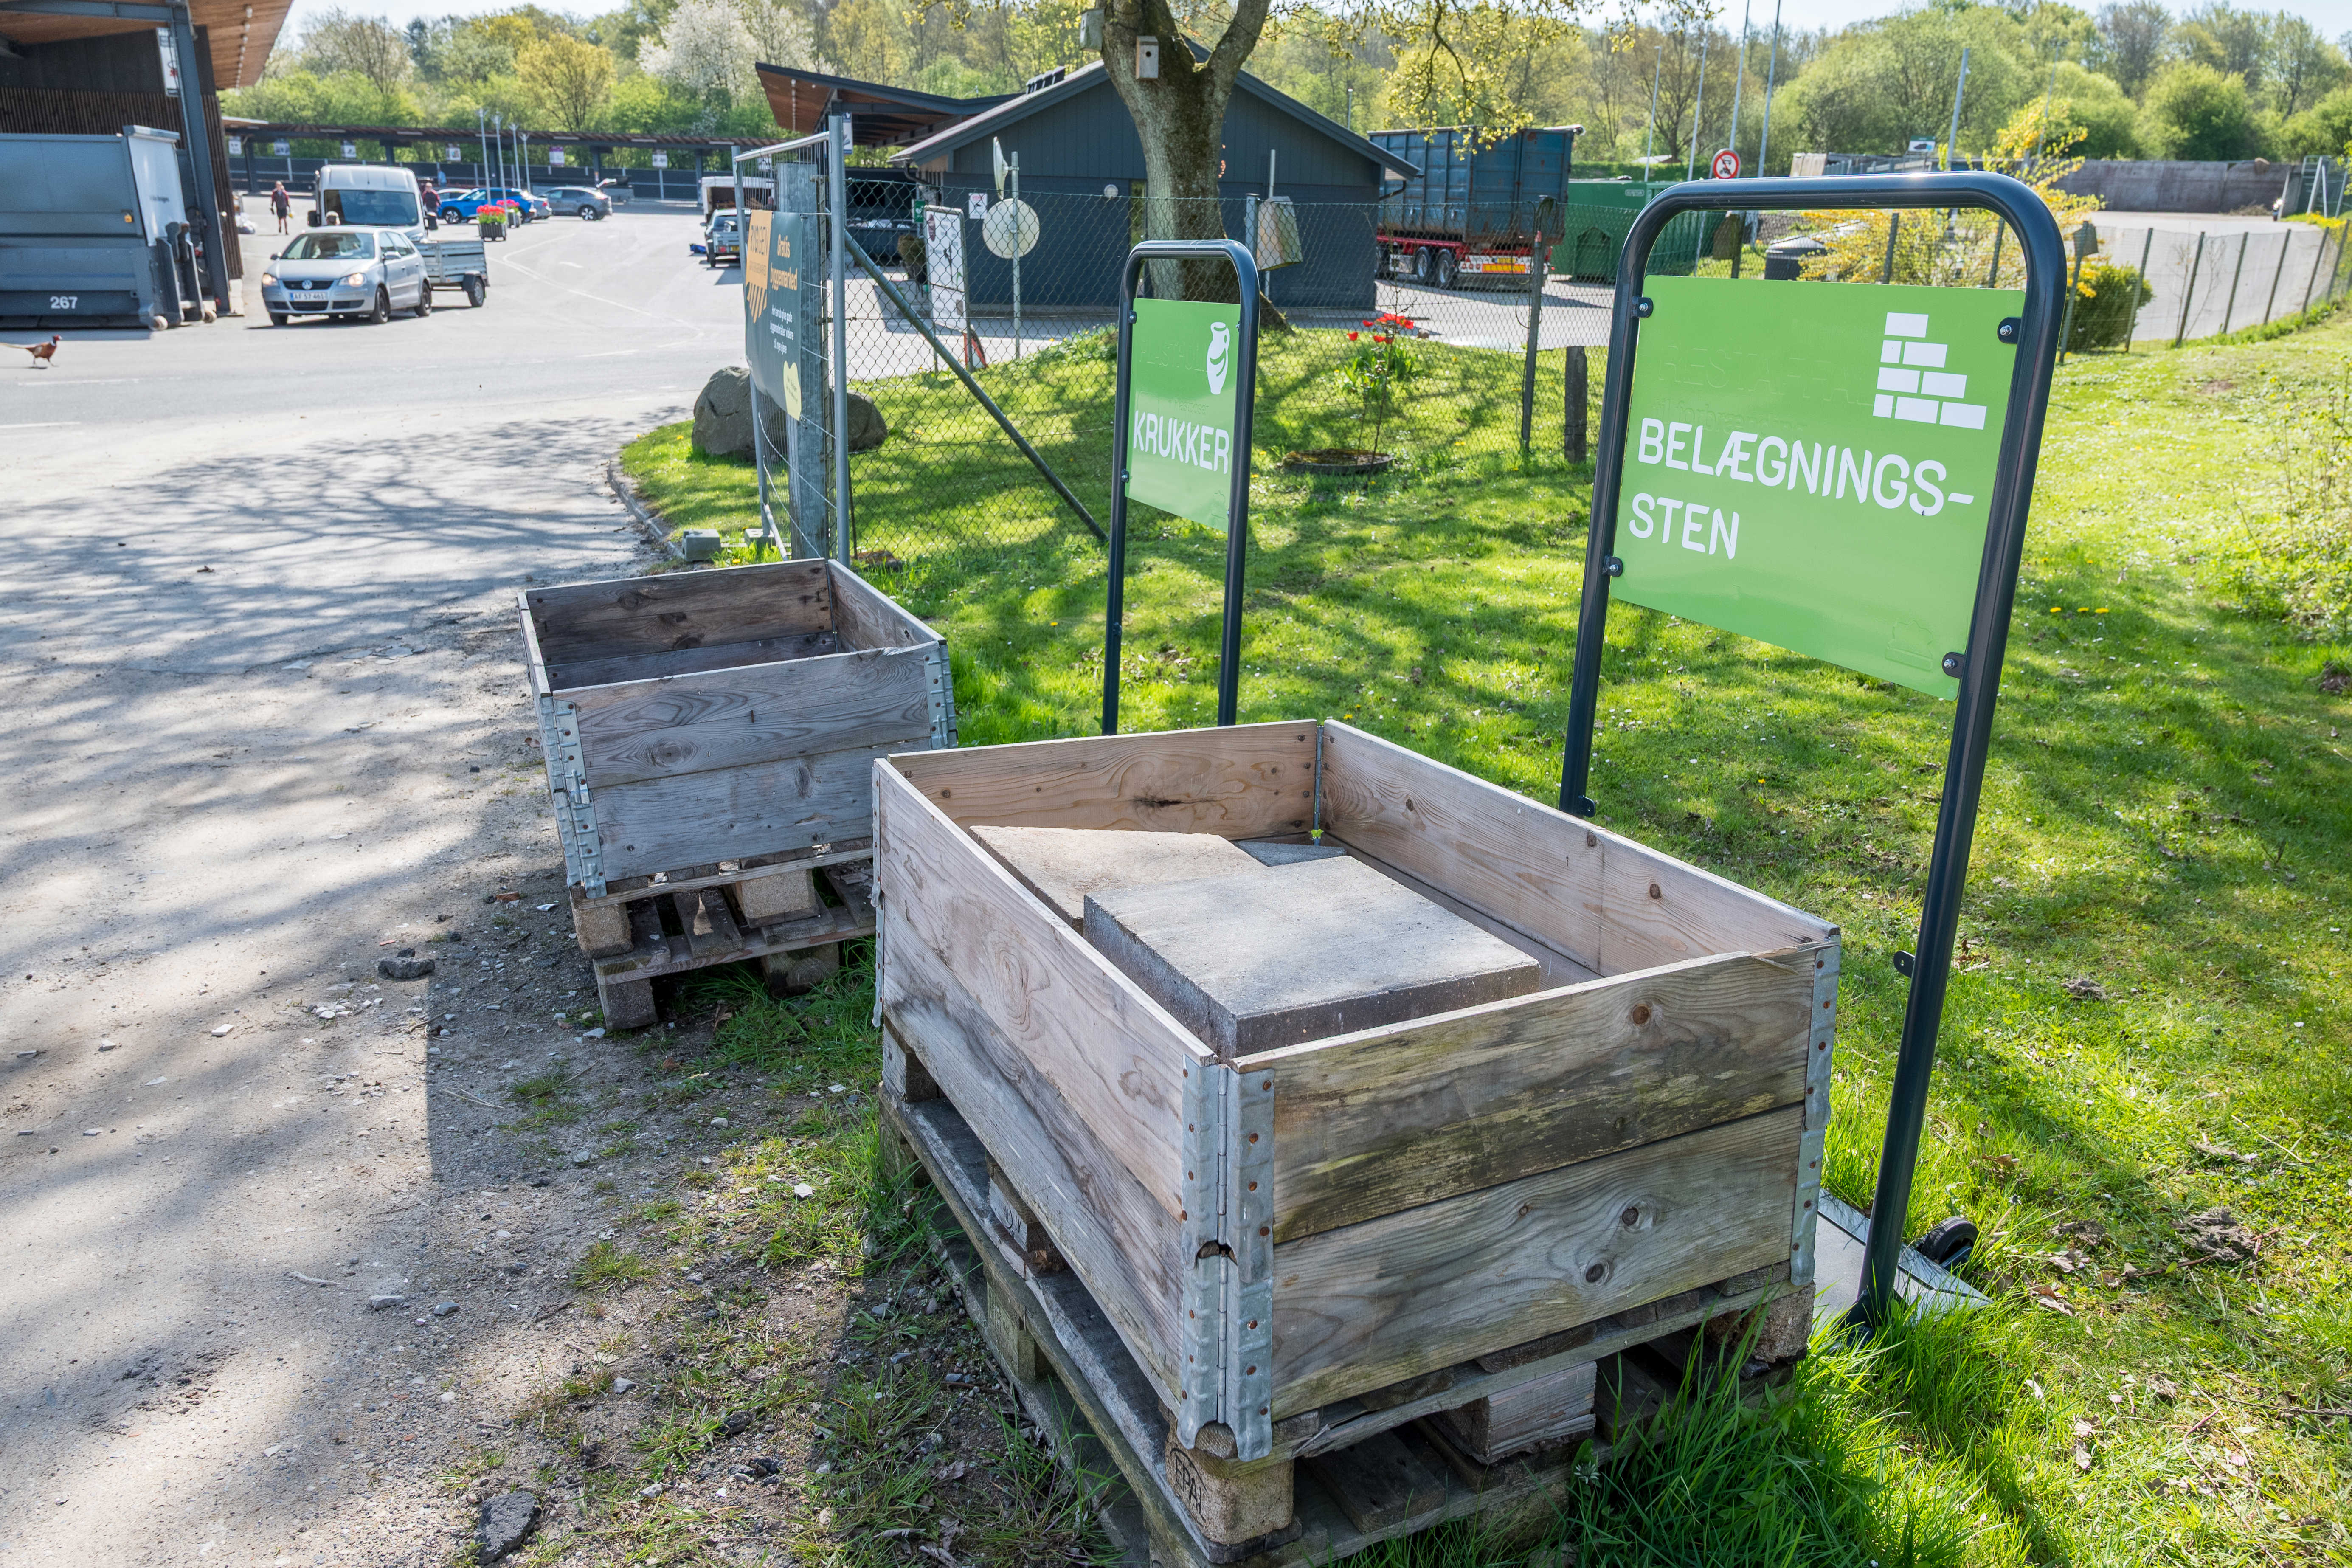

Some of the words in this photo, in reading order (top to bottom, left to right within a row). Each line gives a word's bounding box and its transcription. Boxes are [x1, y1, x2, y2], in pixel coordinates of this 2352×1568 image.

[777, 234, 790, 259] Gratis
[770, 262, 797, 291] byggemarked
[50, 295, 78, 309] 267
[1133, 410, 1230, 474] KRUKKER
[1637, 417, 1974, 516] BELÆGNINGS-
[1629, 493, 1740, 560] STEN
